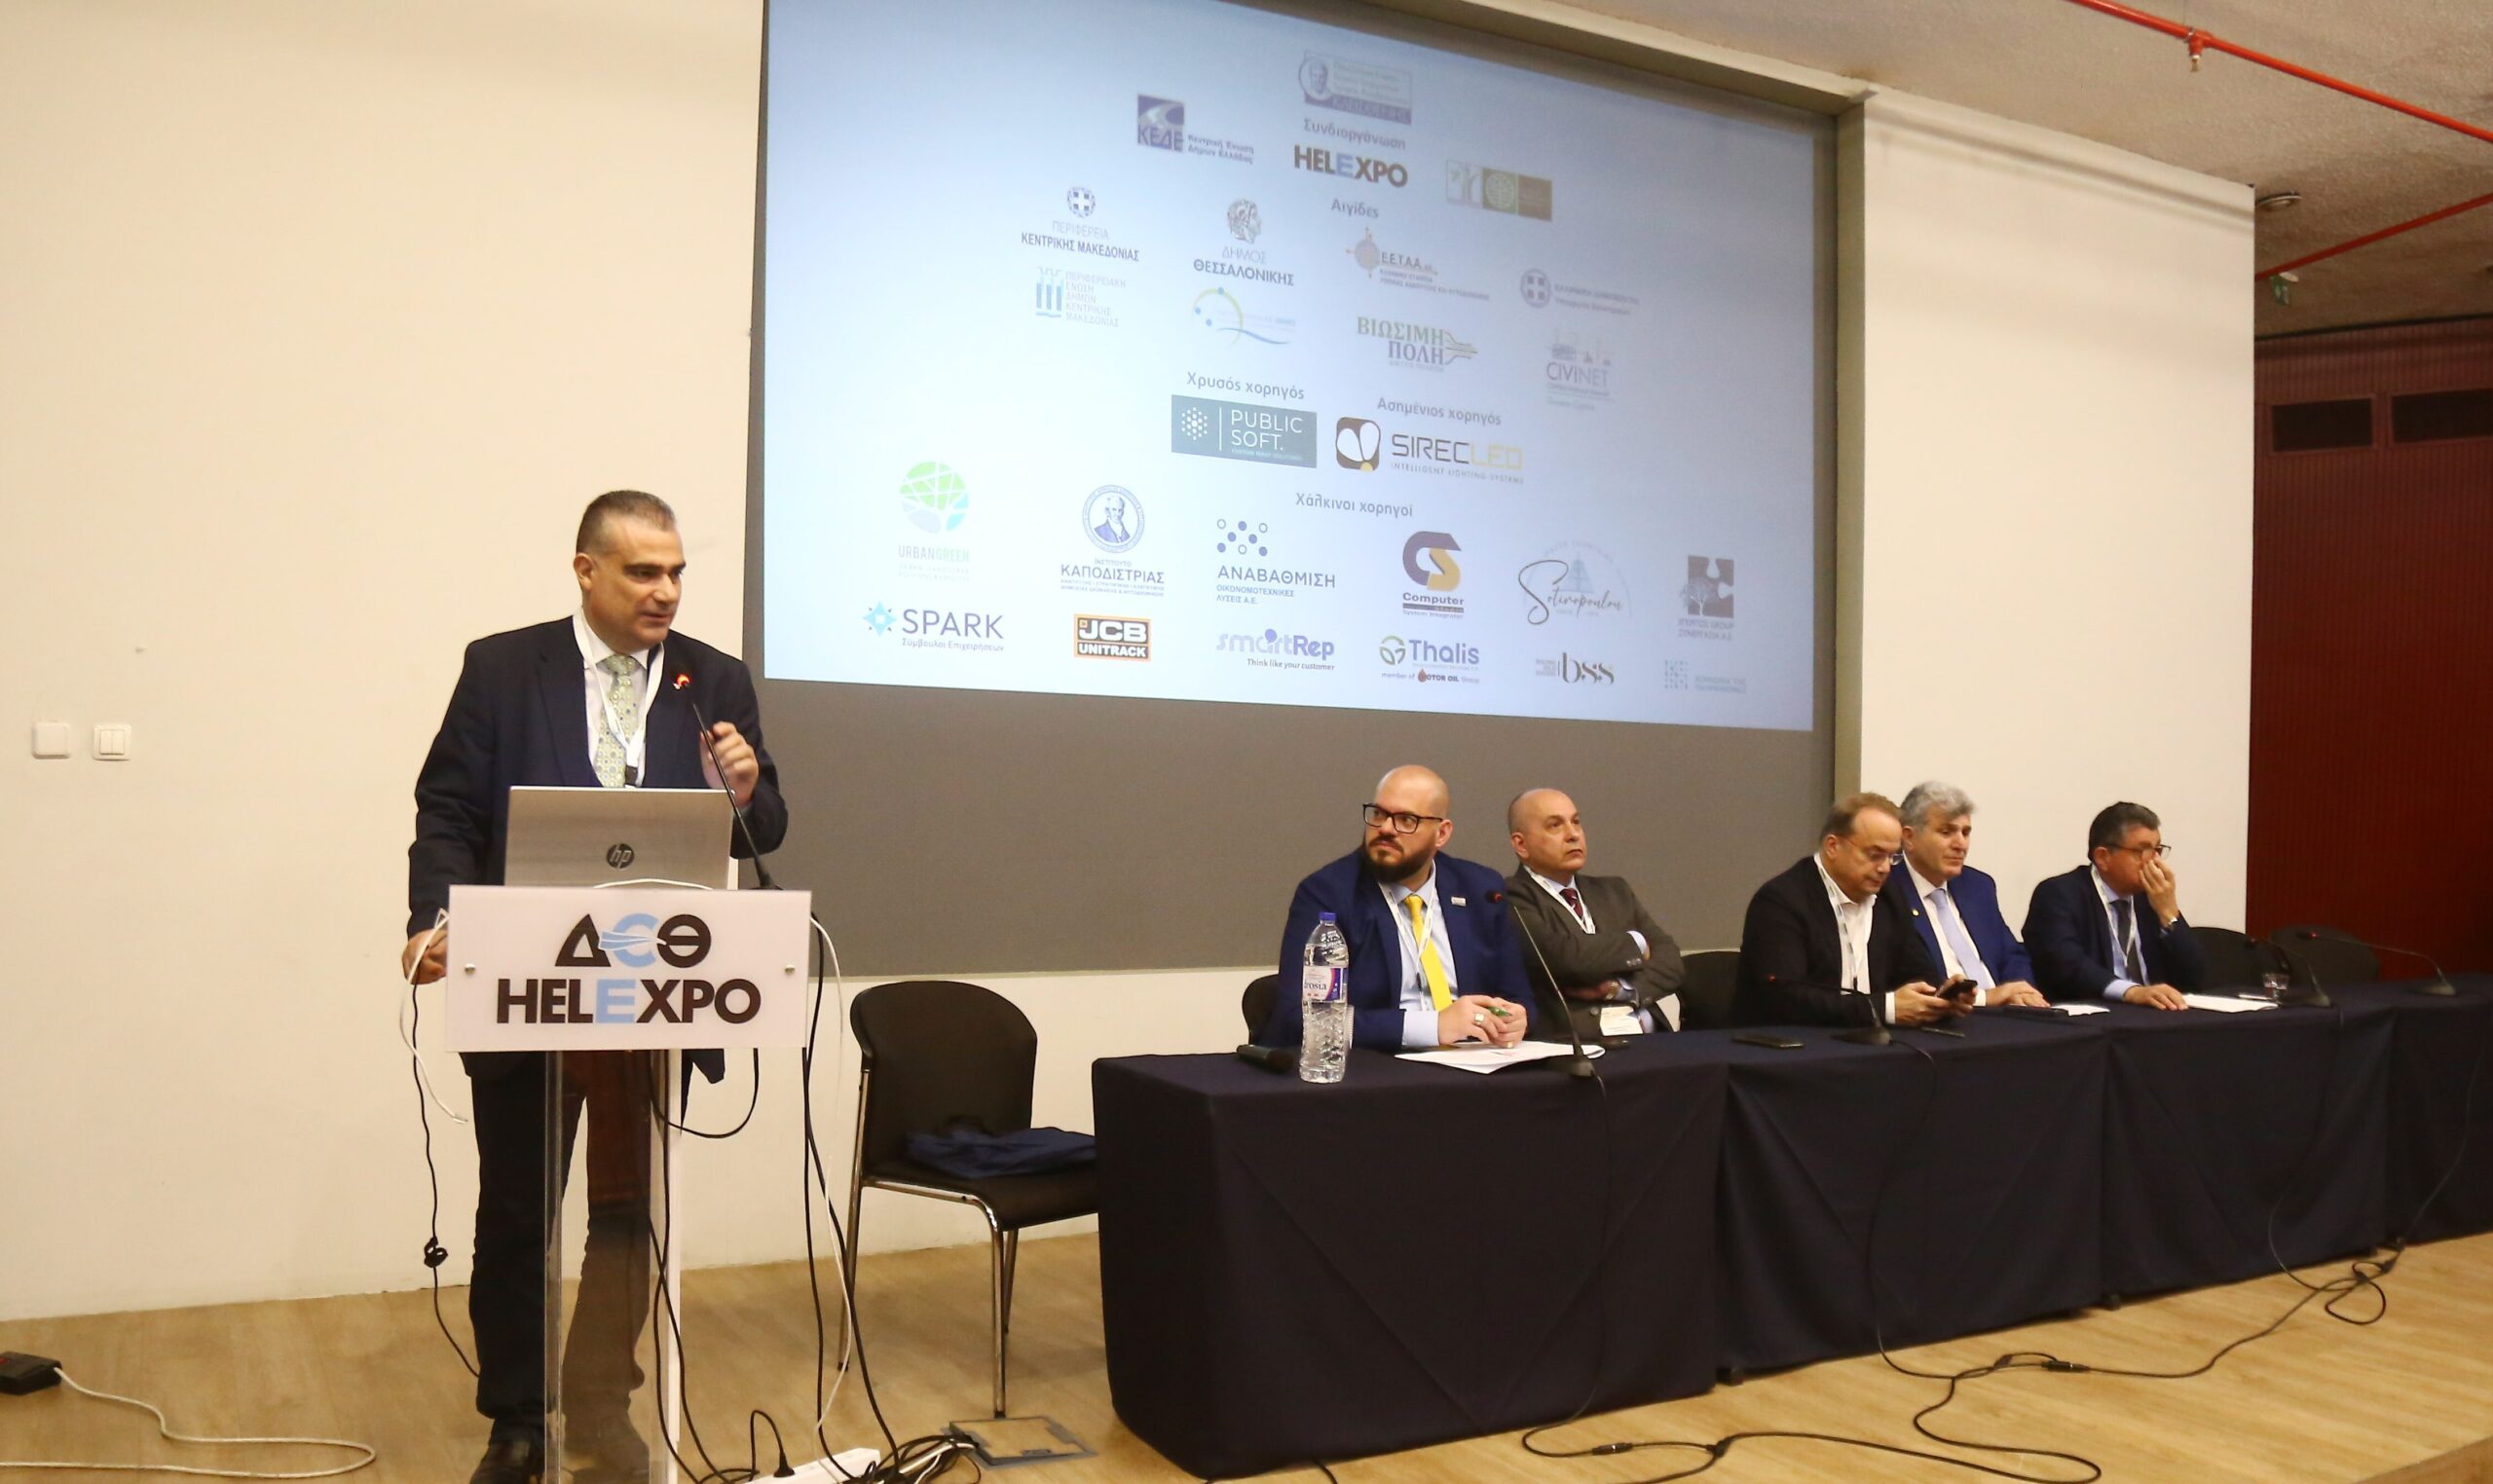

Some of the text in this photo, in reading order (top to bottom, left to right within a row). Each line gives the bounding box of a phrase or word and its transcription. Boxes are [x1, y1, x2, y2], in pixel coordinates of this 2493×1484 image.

[1303, 117, 1405, 150] Συνδιοργάνωση
[1294, 144, 1408, 188] HELEXPO
[1330, 198, 1379, 219] Αιγίδες
[1052, 220, 1110, 240] ΠΕΡΙΦΕΡΕΙΑ
[1021, 232, 1140, 262] ΚΕΝΤΡΙΚΗΣ ΜΑΚΕΔΟΝΙΑΣ
[1222, 246, 1268, 265] ΔΗΜΟΣ
[1193, 258, 1294, 286] ΘΕΣΣΑΛΟΝΙΚΗΣ
[1358, 316, 1444, 347] ΒΙΩΣΙΜΗ
[1388, 340, 1444, 365] ΠΟΛΗ
[1187, 371, 1305, 401] Χρυσός χορηγός
[1546, 361, 1610, 387] CIVINET
[1231, 409, 1303, 433] PUBLIC
[1377, 396, 1502, 427] Ασημένιος χορηγός
[1231, 428, 1284, 451] SOFT.
[1391, 432, 1523, 470] SIRECLED
[1295, 492, 1413, 519] Χάλκινοι χορηγοί
[1060, 564, 1166, 584] ΚΑΠΟΔΙΣΤΡΙΑΣ
[1217, 565, 1336, 588] ΑΝΑΒΑΘΜΙΣΗ
[1402, 592, 1465, 606] Computer
[902, 608, 1005, 640] SPARK
[1079, 619, 1146, 643] JCB
[1079, 644, 1146, 657] UNITRACK
[1216, 629, 1335, 660] smartRep
[1409, 640, 1479, 665] Thalis
[1246, 658, 1268, 668] Think
[1269, 659, 1283, 668] like
[1562, 651, 1615, 685] bss
[608, 843, 634, 869] hp
[497, 977, 763, 1024] HELEXPO
